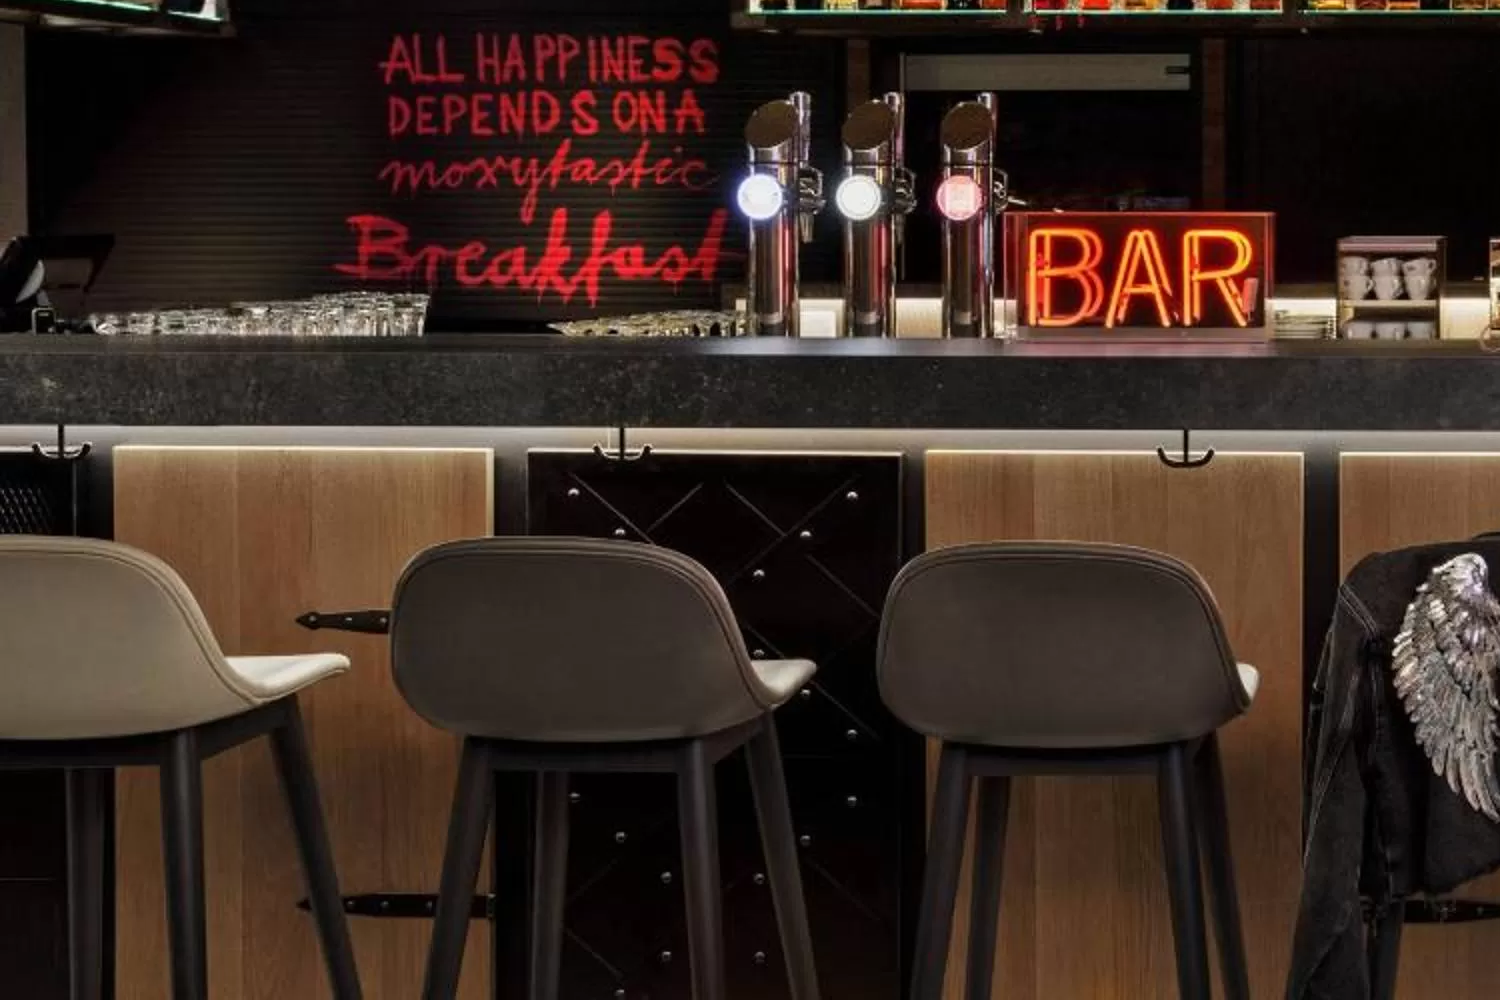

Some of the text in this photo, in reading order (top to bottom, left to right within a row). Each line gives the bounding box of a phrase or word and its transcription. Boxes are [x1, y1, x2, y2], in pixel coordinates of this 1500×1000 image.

[379, 33, 720, 85] ALL HAPPINESS
[389, 90, 706, 137] DEPENDS ON A
[332, 207, 746, 308] Breakfast
[1026, 227, 1259, 329] BAR
